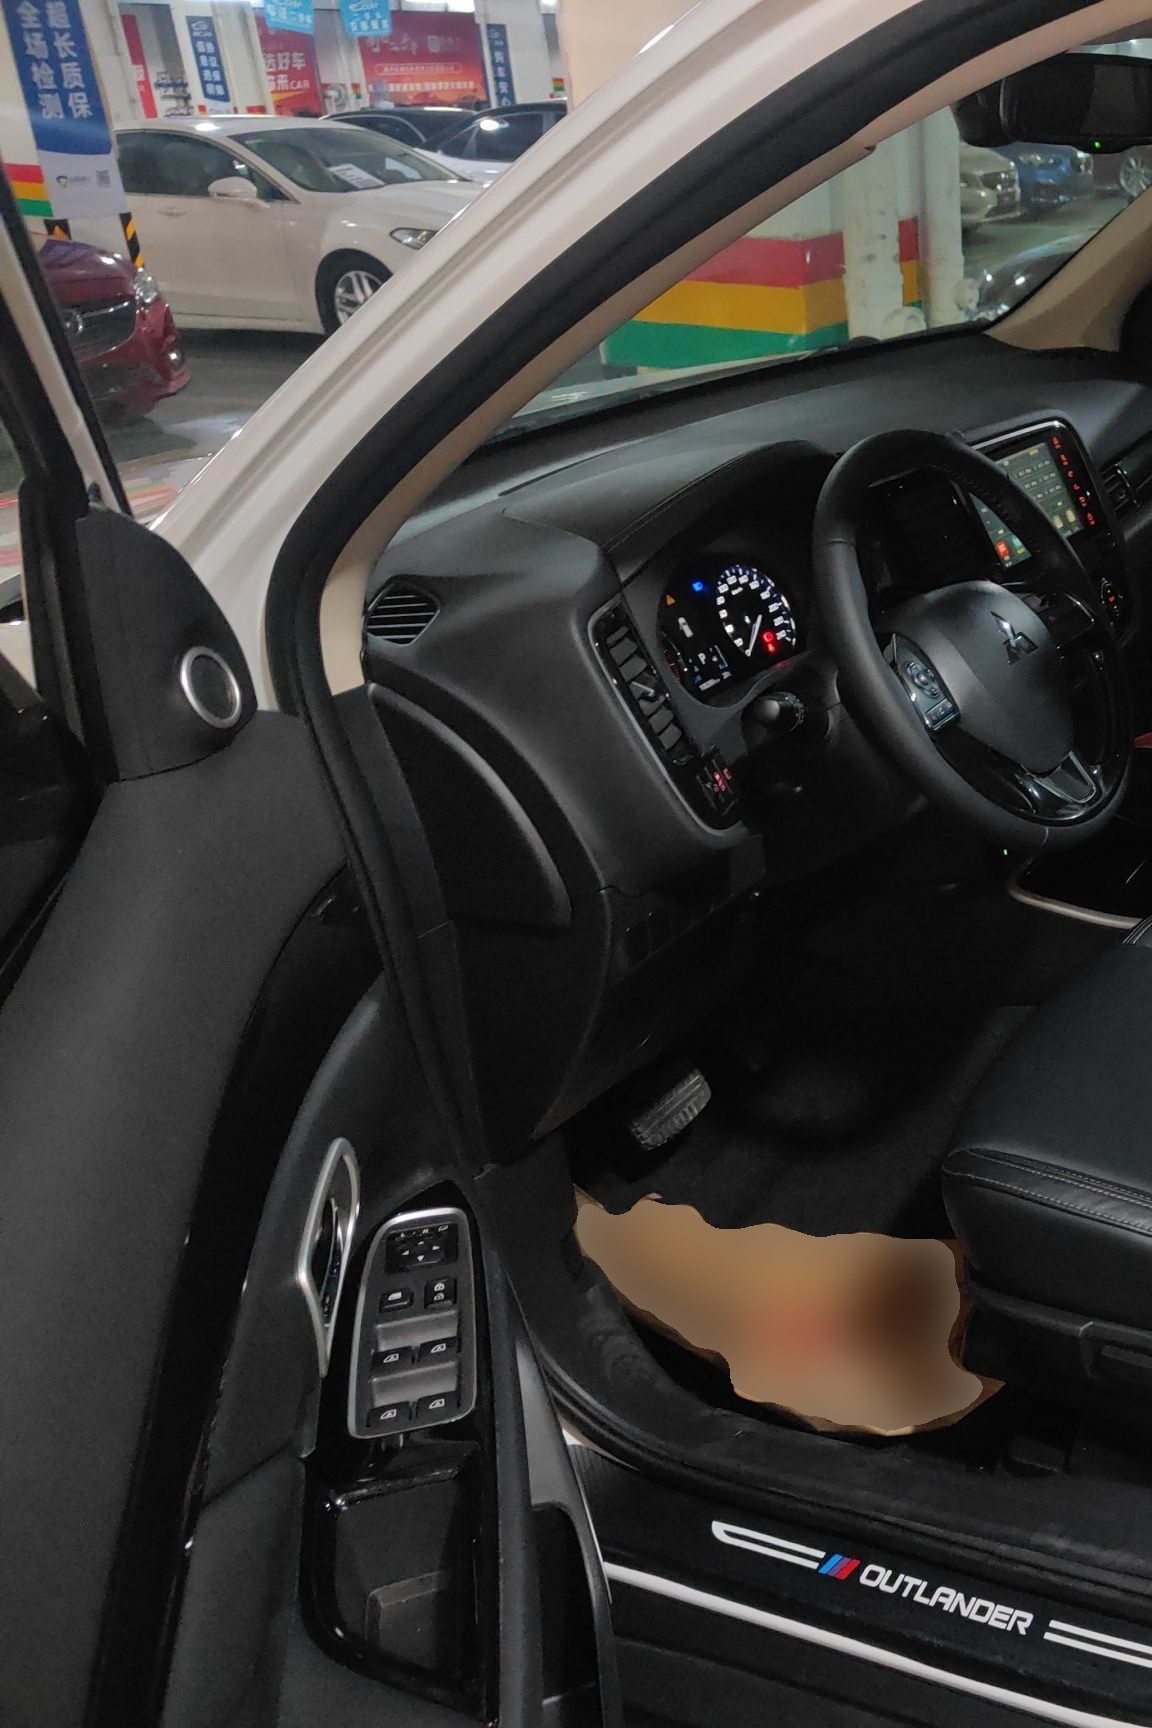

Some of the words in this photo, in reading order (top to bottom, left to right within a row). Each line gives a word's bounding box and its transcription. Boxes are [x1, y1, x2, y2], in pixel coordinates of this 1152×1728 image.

[17, 1, 65, 120] 全场检测
[46, 0, 94, 119] 超长质保
[859, 1563, 1034, 1636] OUTLANDER
